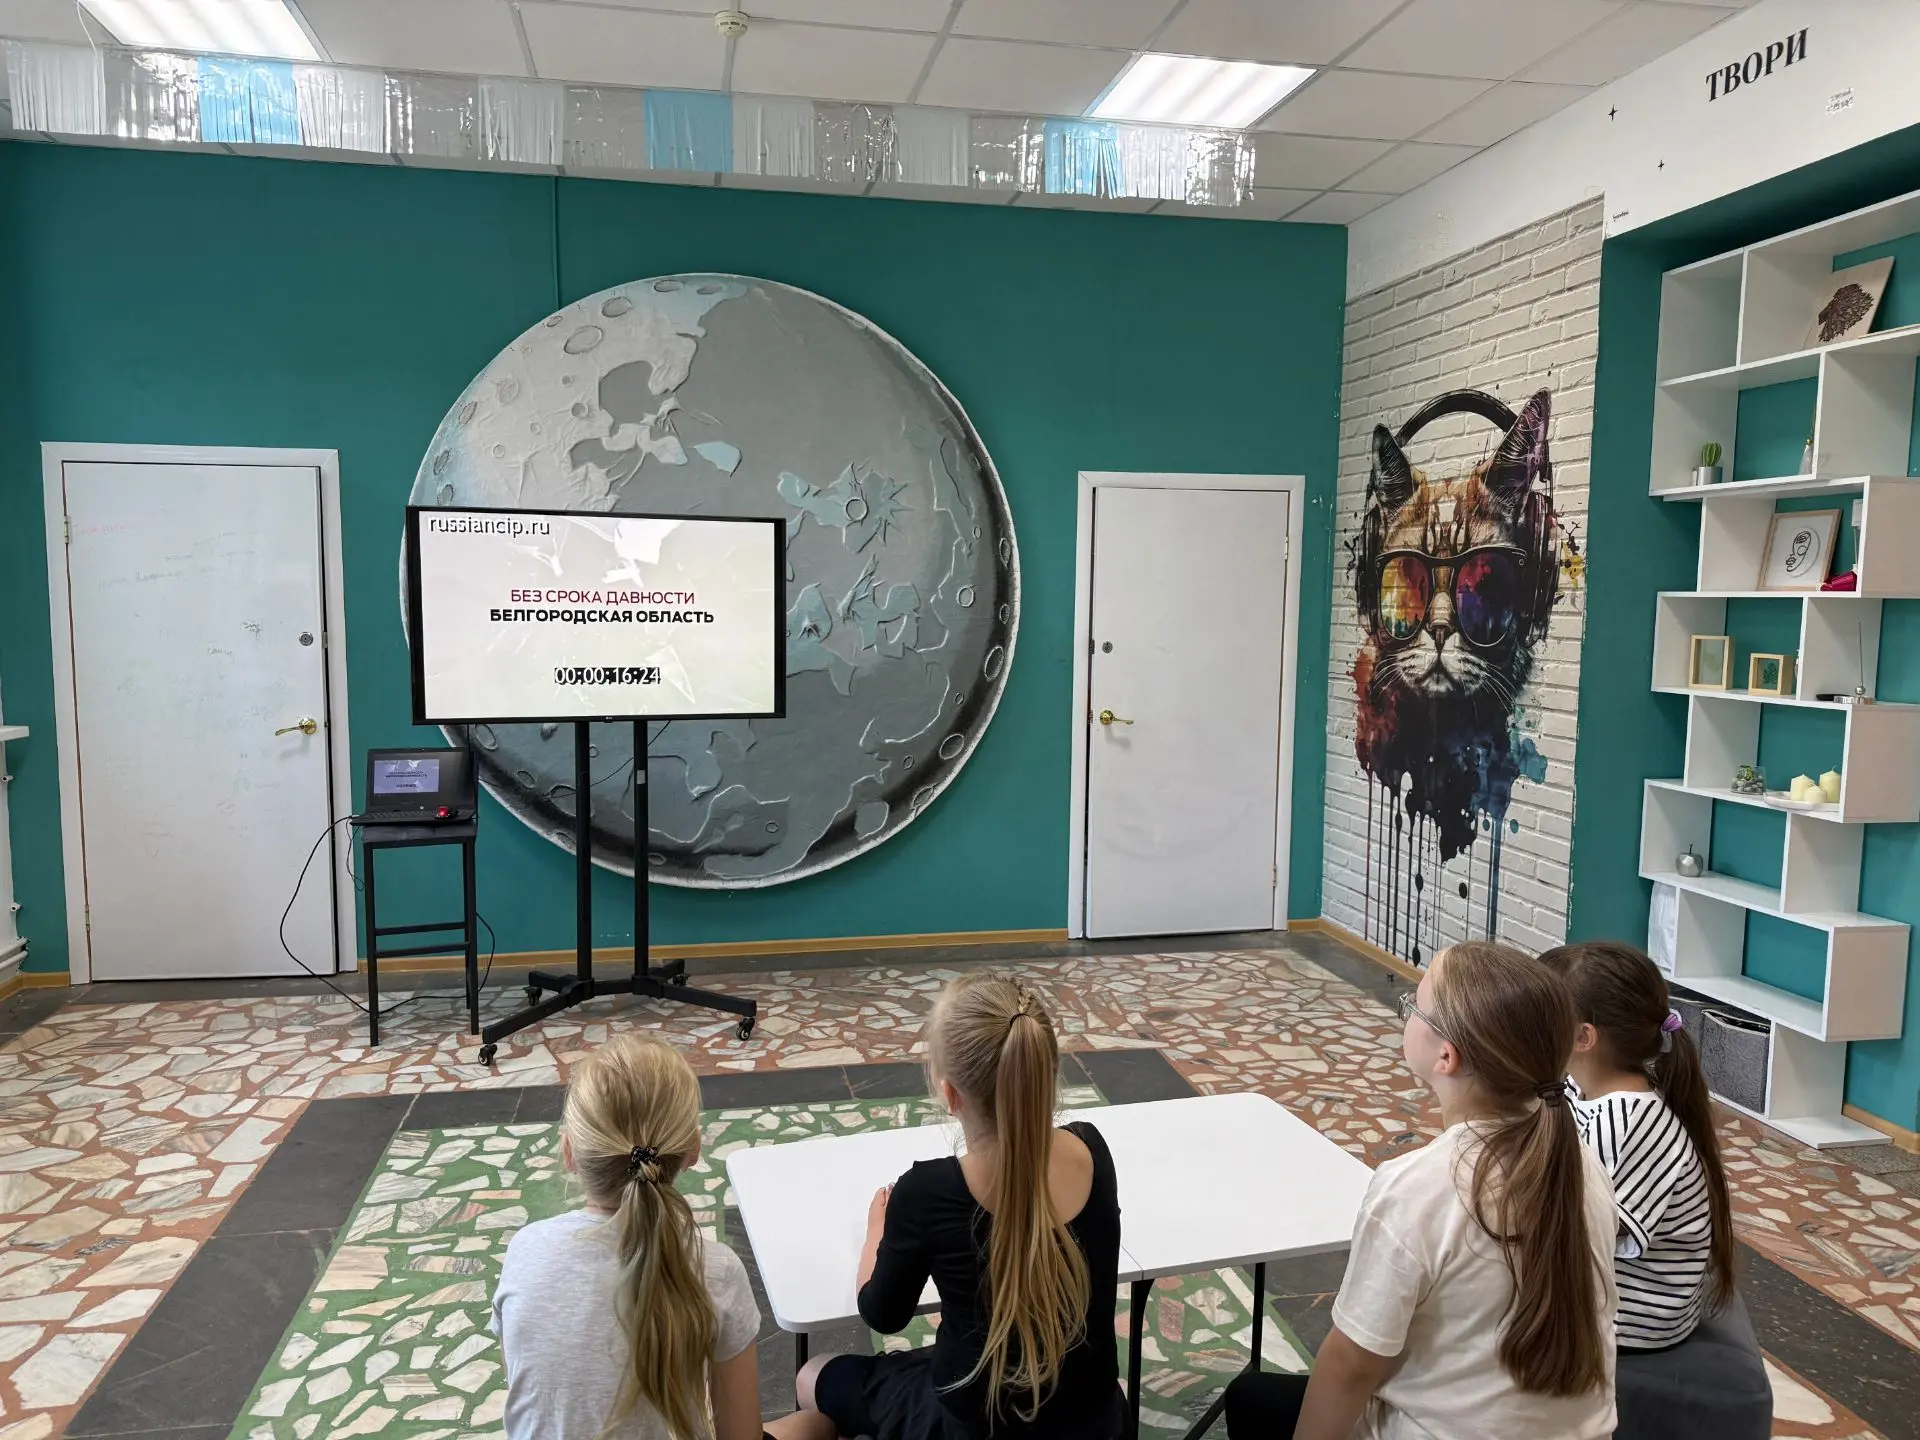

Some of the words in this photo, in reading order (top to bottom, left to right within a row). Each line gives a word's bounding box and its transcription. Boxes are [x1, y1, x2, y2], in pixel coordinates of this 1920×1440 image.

[1706, 27, 1809, 102] ТВОРИ
[429, 516, 550, 538] russiancip.ru
[511, 589, 542, 602] БЕЗ
[546, 590, 602, 603] СРОКА
[606, 591, 695, 605] ДАВНОСТИ
[490, 609, 632, 624] БЕЛГОРОДСКАЯ
[636, 610, 714, 623] ОБЛАСТЬ
